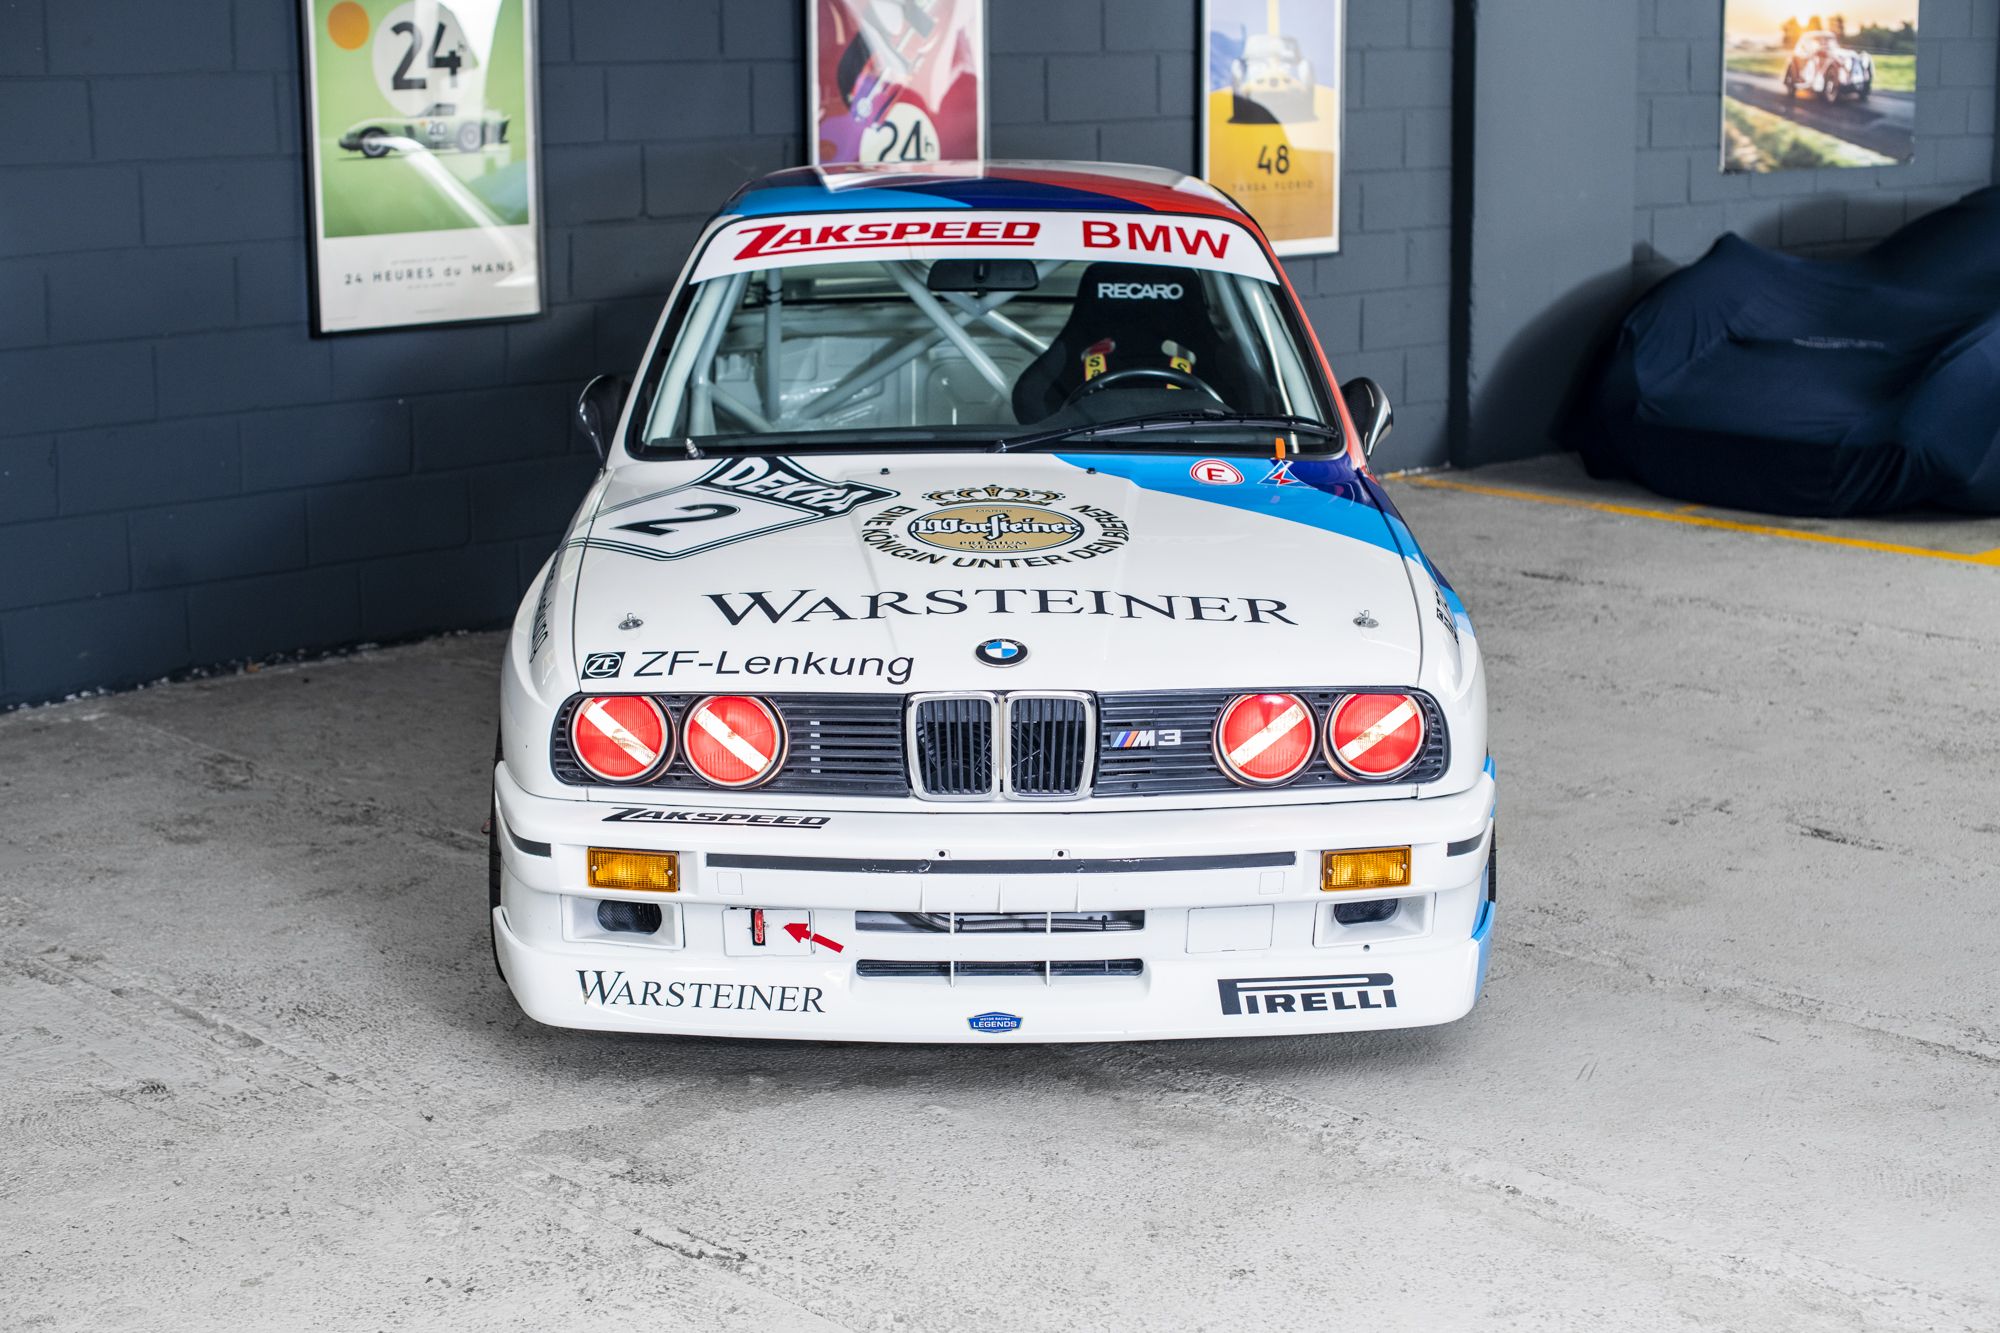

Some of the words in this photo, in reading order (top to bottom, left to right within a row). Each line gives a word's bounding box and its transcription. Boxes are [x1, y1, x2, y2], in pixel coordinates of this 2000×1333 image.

[1257, 145, 1290, 175] 48
[733, 221, 1041, 261] ZAKSPEED
[1082, 221, 1230, 259] BMW
[345, 273, 363, 285] 24
[372, 267, 434, 283] HEURES
[443, 266, 461, 277] du
[471, 260, 516, 275] MANS
[1098, 282, 1183, 300] RECARO
[710, 456, 872, 513] DEKRA
[1206, 467, 1228, 482] E
[610, 503, 741, 536] 2
[863, 505, 918, 527] EINE
[862, 528, 949, 564] KÖNIGIN
[1067, 539, 1125, 560] DEN
[952, 554, 1073, 569] UNTER
[701, 588, 1299, 627] WARSTEINER
[586, 656, 621, 673] ZF
[634, 650, 915, 686] ZF-Lenkung
[1131, 729, 1182, 747] M3
[602, 807, 831, 829] ZAKSPEED
[576, 970, 826, 1013] WARSTEINER
[1217, 972, 1398, 1015] PIRELLI
[973, 1020, 1017, 1028] LEGENDS
